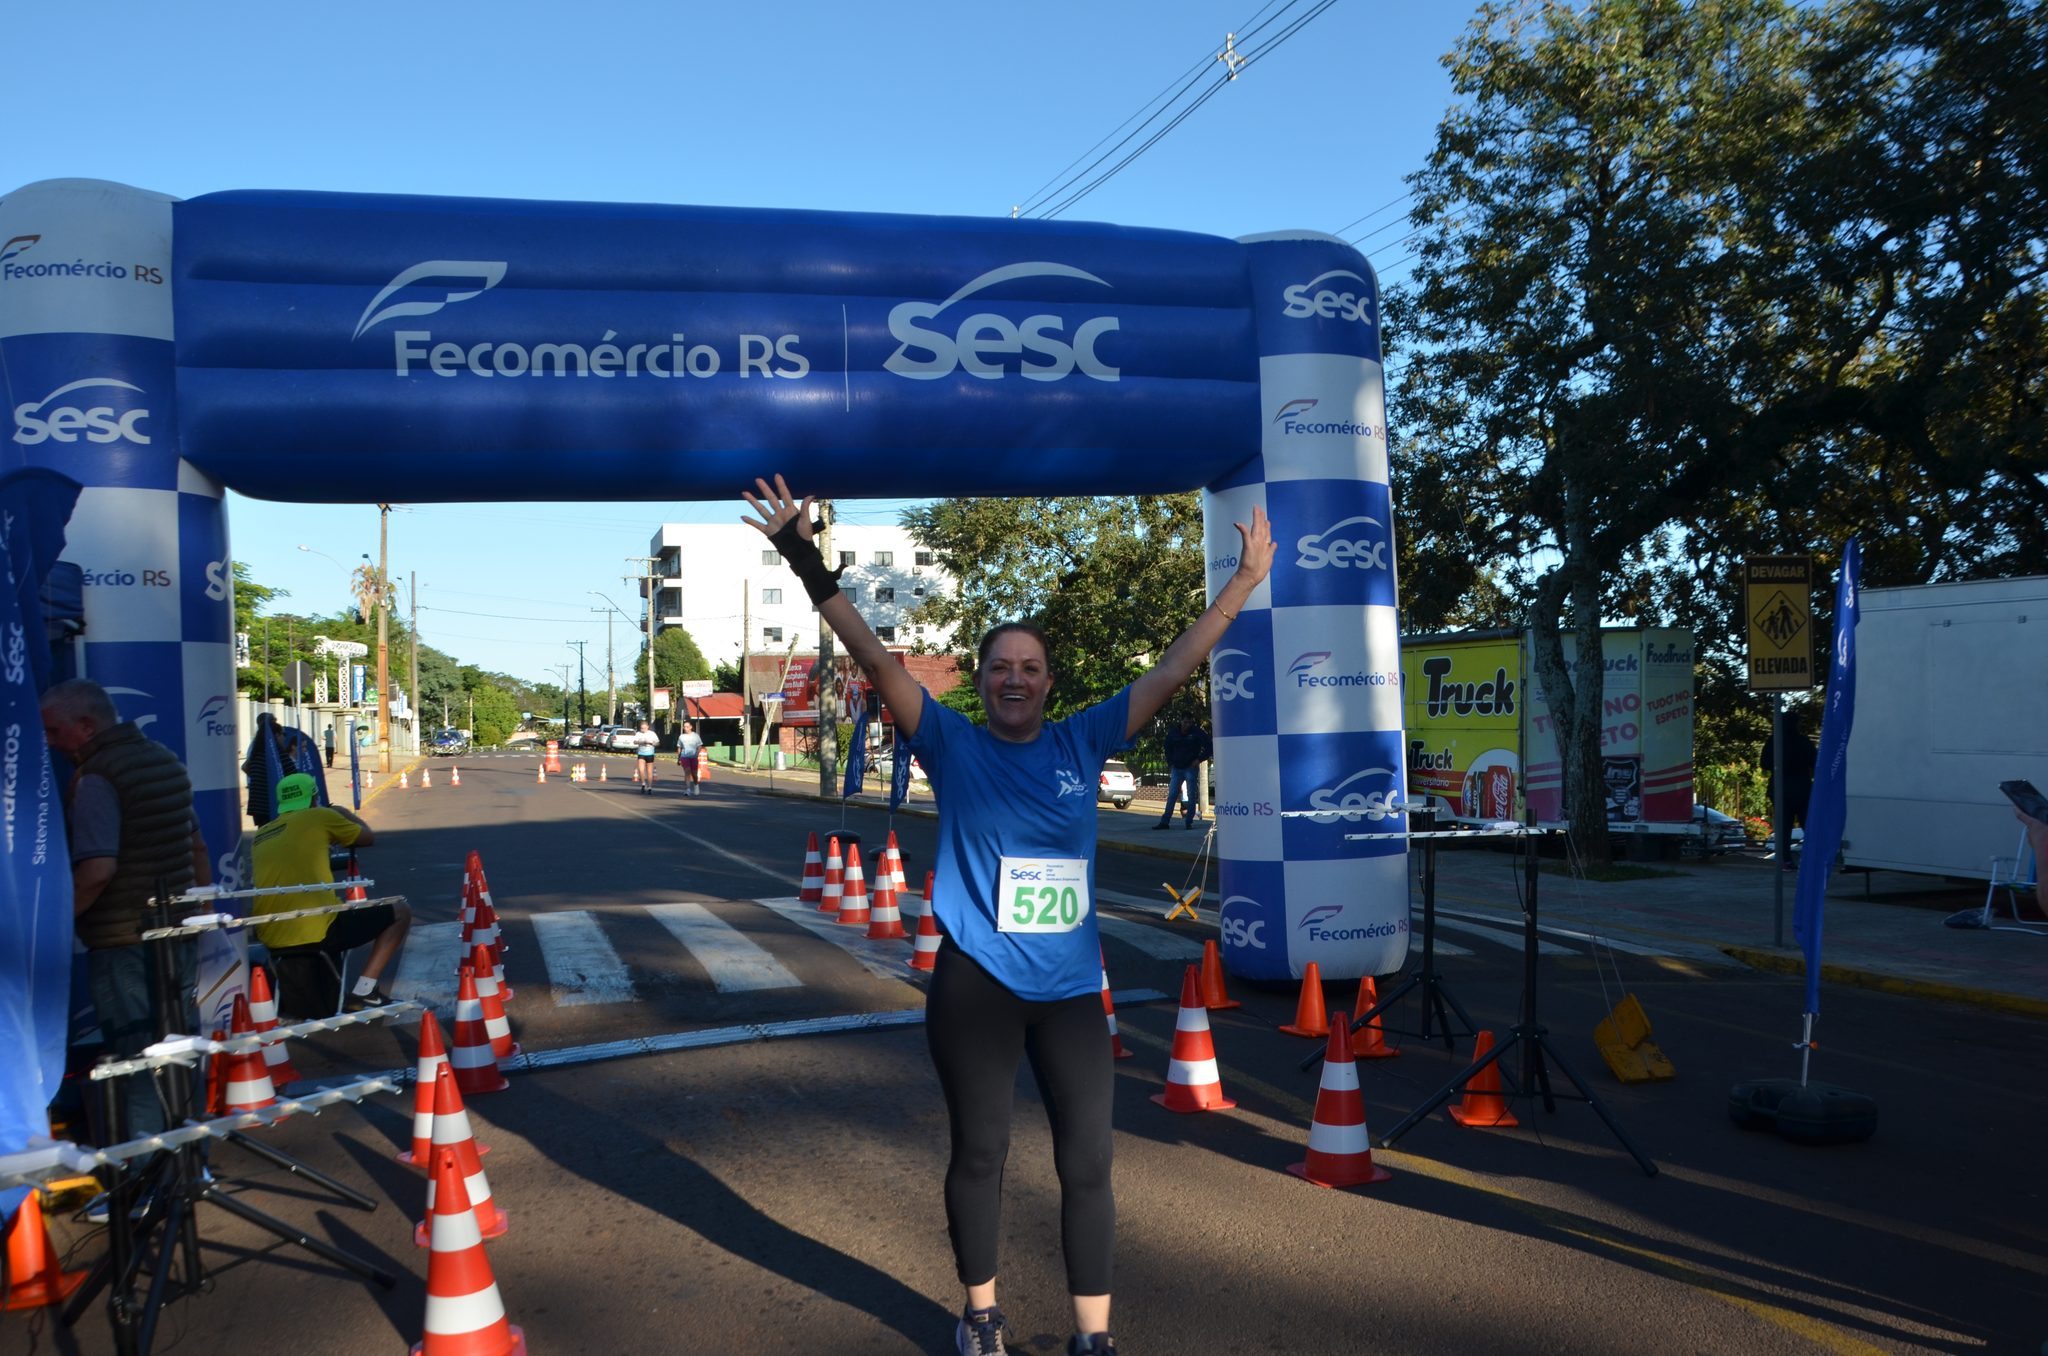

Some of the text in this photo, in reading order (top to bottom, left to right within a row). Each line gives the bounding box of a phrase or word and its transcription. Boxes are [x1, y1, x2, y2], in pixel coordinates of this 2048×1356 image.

[4, 258, 164, 285] Fecomércio RS
[1281, 284, 1372, 327] Sesc
[394, 300, 1121, 382] Fecomércio RS Sesc
[12, 401, 151, 446] Sesc
[1284, 419, 1385, 441] Fecomércio RS
[1295, 533, 1388, 571] Sesc
[82, 568, 172, 588] ércio RS
[1751, 565, 1806, 578] DEVAGAR
[1754, 657, 1808, 674] ELEVADA
[1210, 669, 1255, 702] esc
[1297, 671, 1399, 689] Fecomércio RS
[1423, 657, 1516, 719] Truck
[1604, 693, 1641, 717] NO
[1655, 706, 1689, 725] ESPETO
[1253, 802, 1274, 816] RS
[1307, 789, 1399, 824] Sesc
[1011, 869, 1041, 881] Sesc
[1012, 886, 1079, 925] 520
[1221, 917, 1267, 950] esc
[1309, 916, 1409, 942] Fecomércio RS
